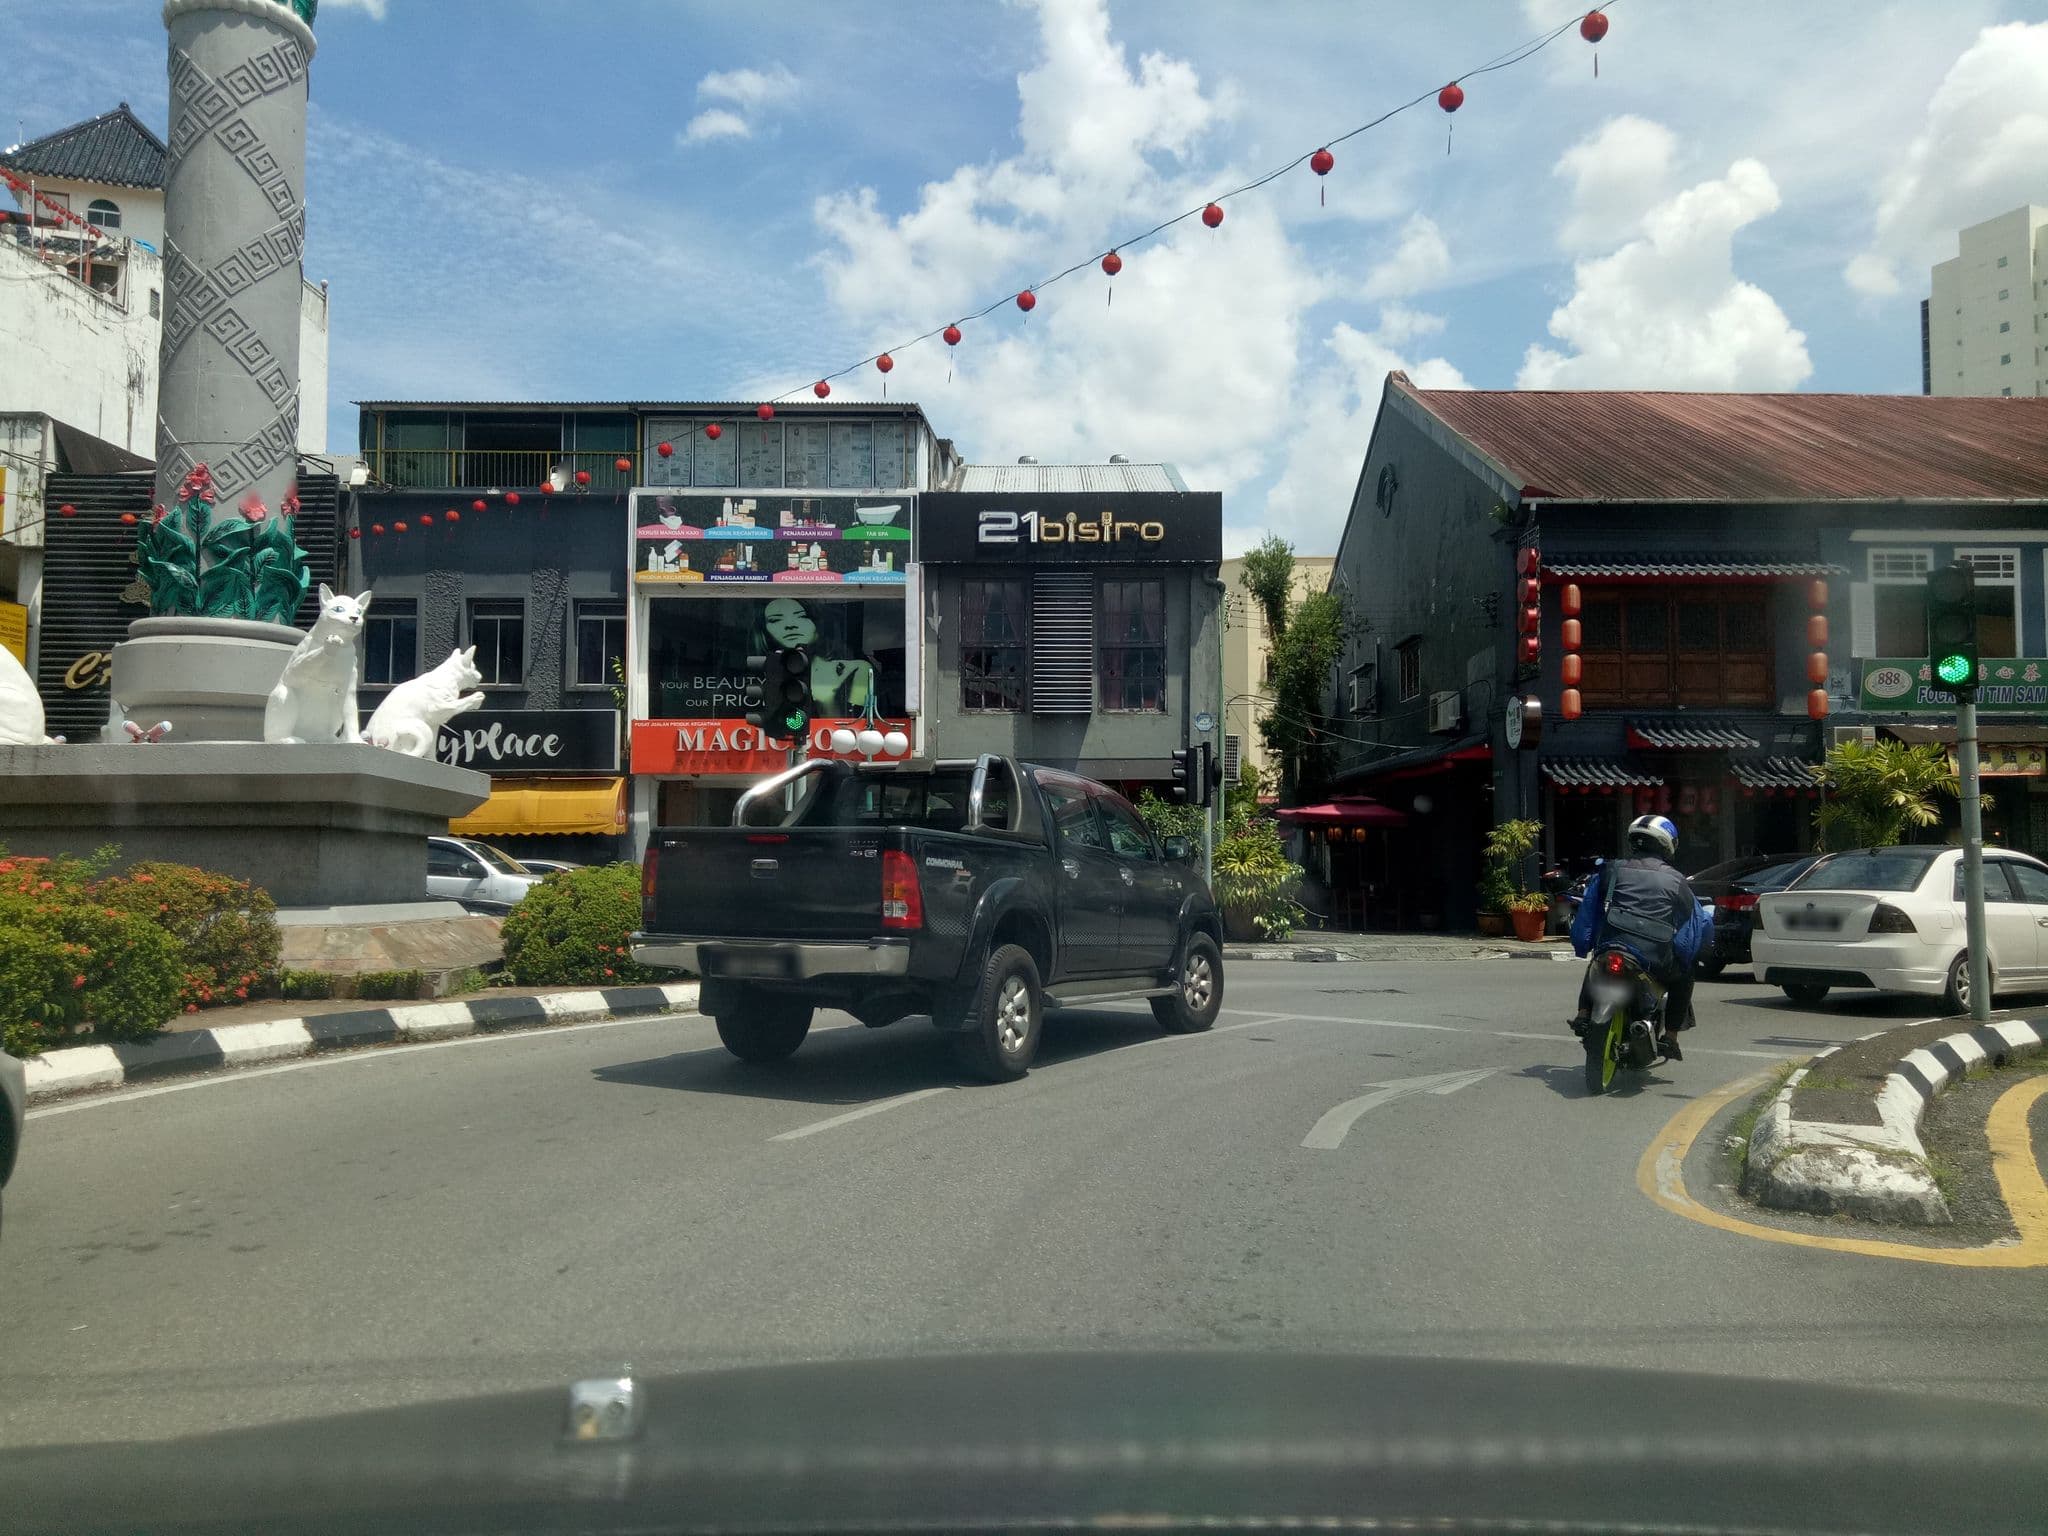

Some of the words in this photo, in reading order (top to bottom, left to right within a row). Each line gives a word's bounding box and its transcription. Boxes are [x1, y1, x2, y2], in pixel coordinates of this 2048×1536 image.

[660, 681, 689, 689] YOUR
[693, 676, 767, 689] BEAUTY
[1878, 671, 1901, 686] 888
[1986, 686, 2014, 704] TIM
[2015, 686, 2048, 704] SAM
[685, 699, 709, 707] OUR
